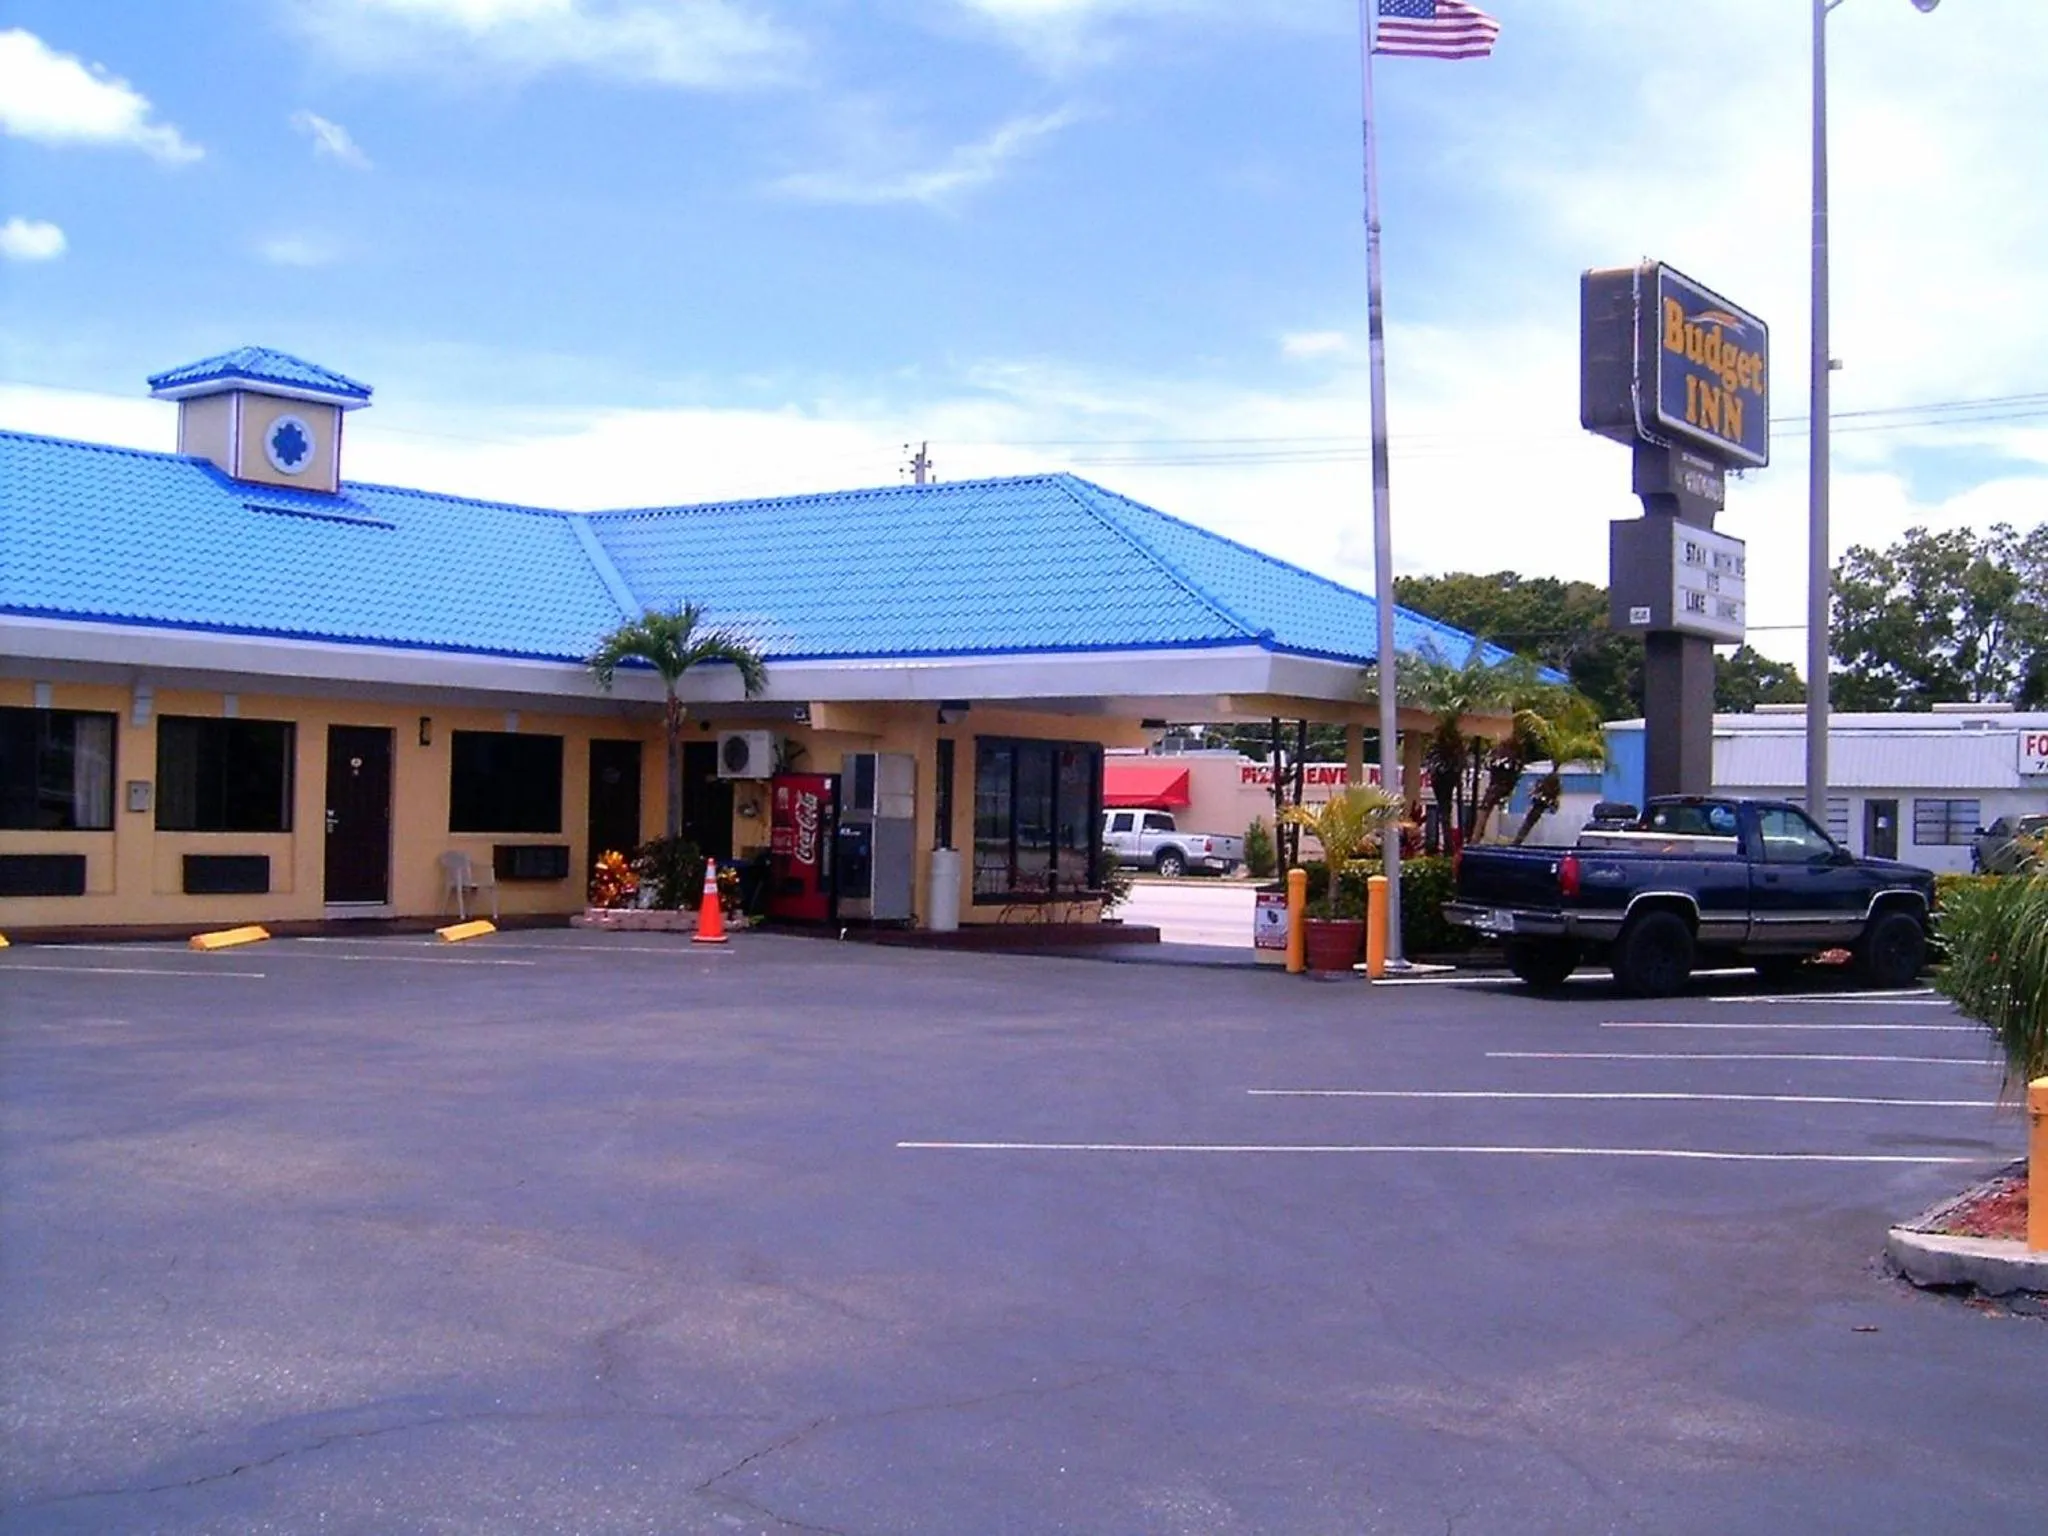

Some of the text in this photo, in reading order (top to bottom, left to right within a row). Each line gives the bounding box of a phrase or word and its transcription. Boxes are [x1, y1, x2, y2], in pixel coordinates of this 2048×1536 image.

[1663, 296, 1763, 395] Budget
[1686, 373, 1743, 443] INN
[1685, 541, 1707, 565] STAY
[1685, 590, 1706, 615] LIKE
